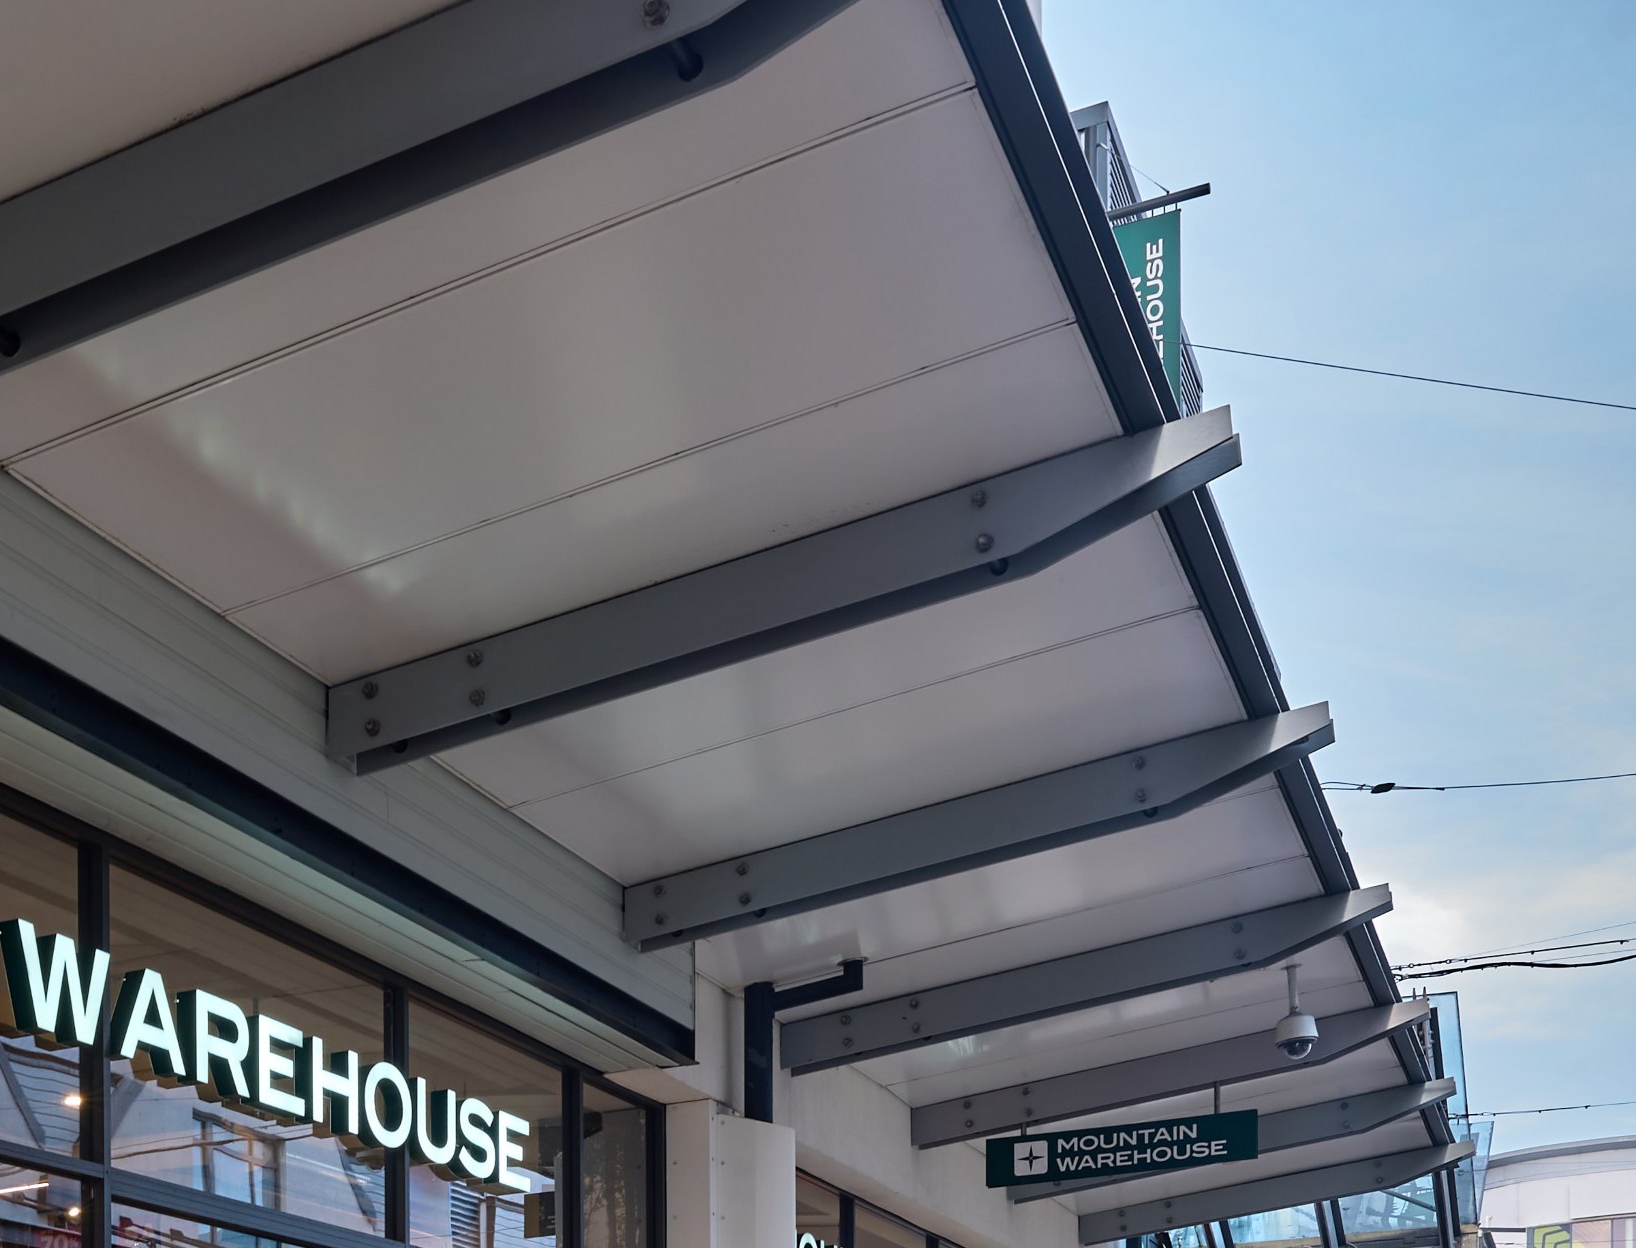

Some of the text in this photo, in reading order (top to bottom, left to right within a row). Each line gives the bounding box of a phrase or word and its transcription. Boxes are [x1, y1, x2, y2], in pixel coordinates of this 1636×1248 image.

[0, 917, 531, 1193] WAREHOUSE
[1057, 1123, 1198, 1154] MOUNTAIN
[1056, 1139, 1228, 1172] WAREHOUSE
